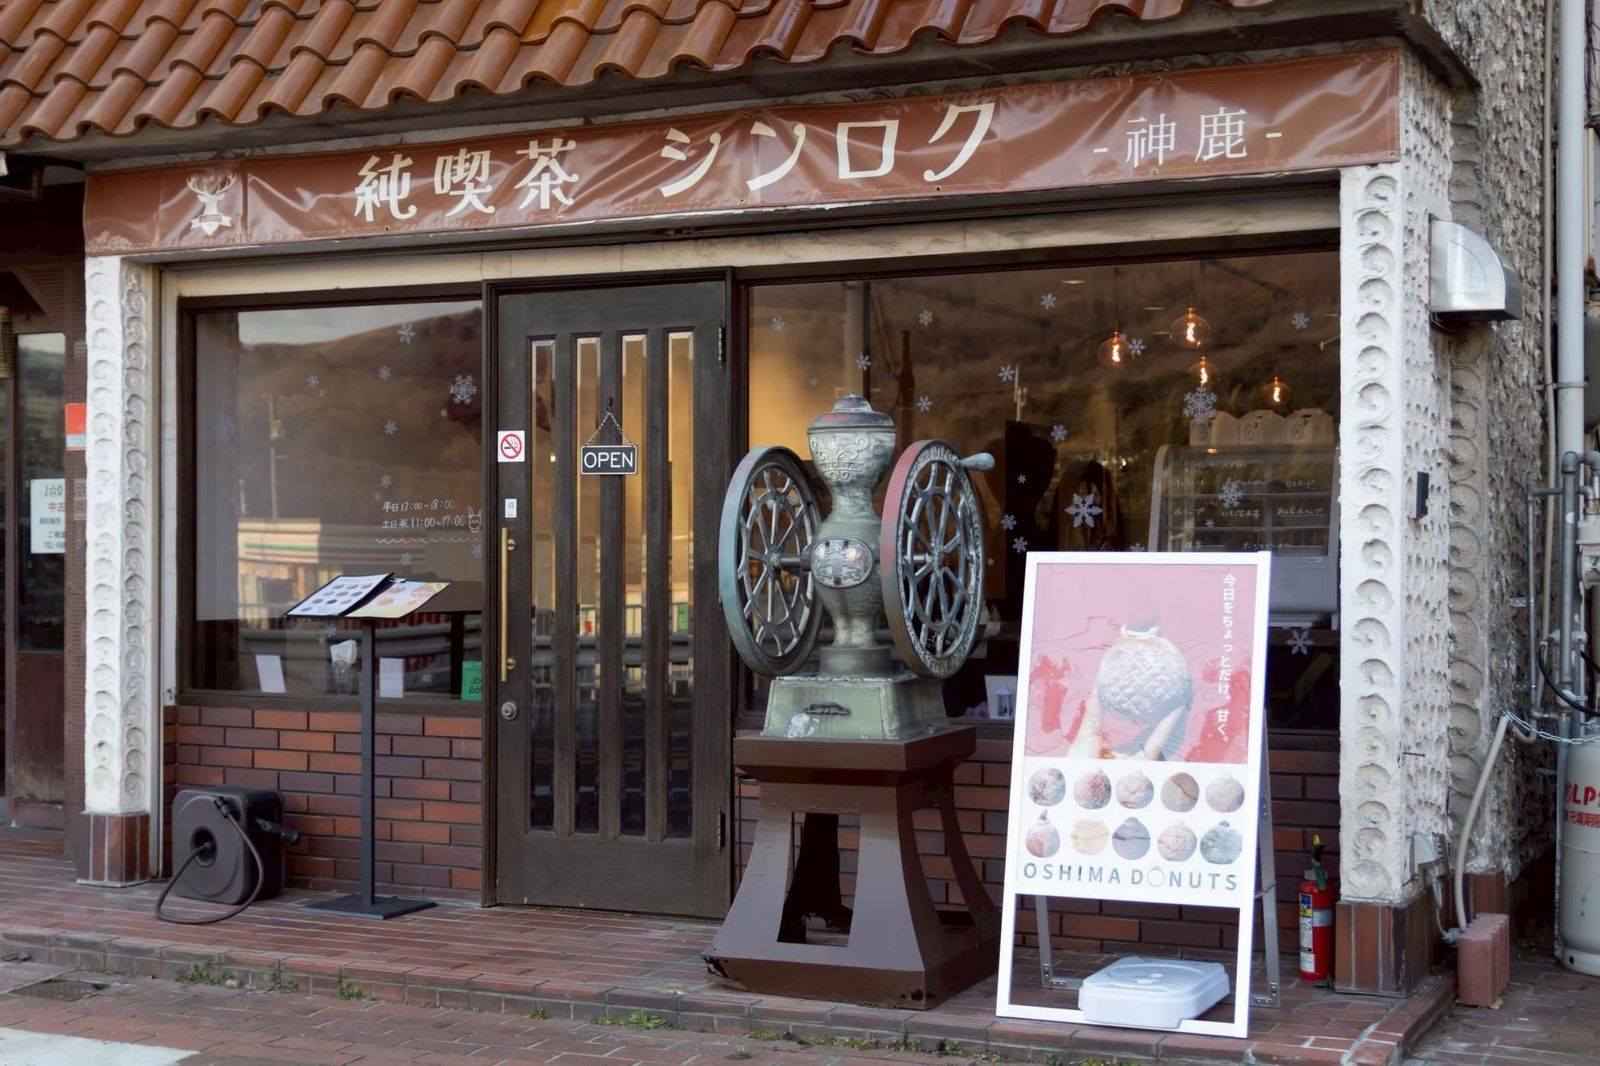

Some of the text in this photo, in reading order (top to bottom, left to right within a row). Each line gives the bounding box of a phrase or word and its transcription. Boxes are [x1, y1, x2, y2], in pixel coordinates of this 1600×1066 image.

[353, 137, 581, 223] 純喫茶
[659, 102, 996, 198] シンロク
[584, 451, 634, 469] OPEN
[1024, 862, 1121, 885] OSHIMA
